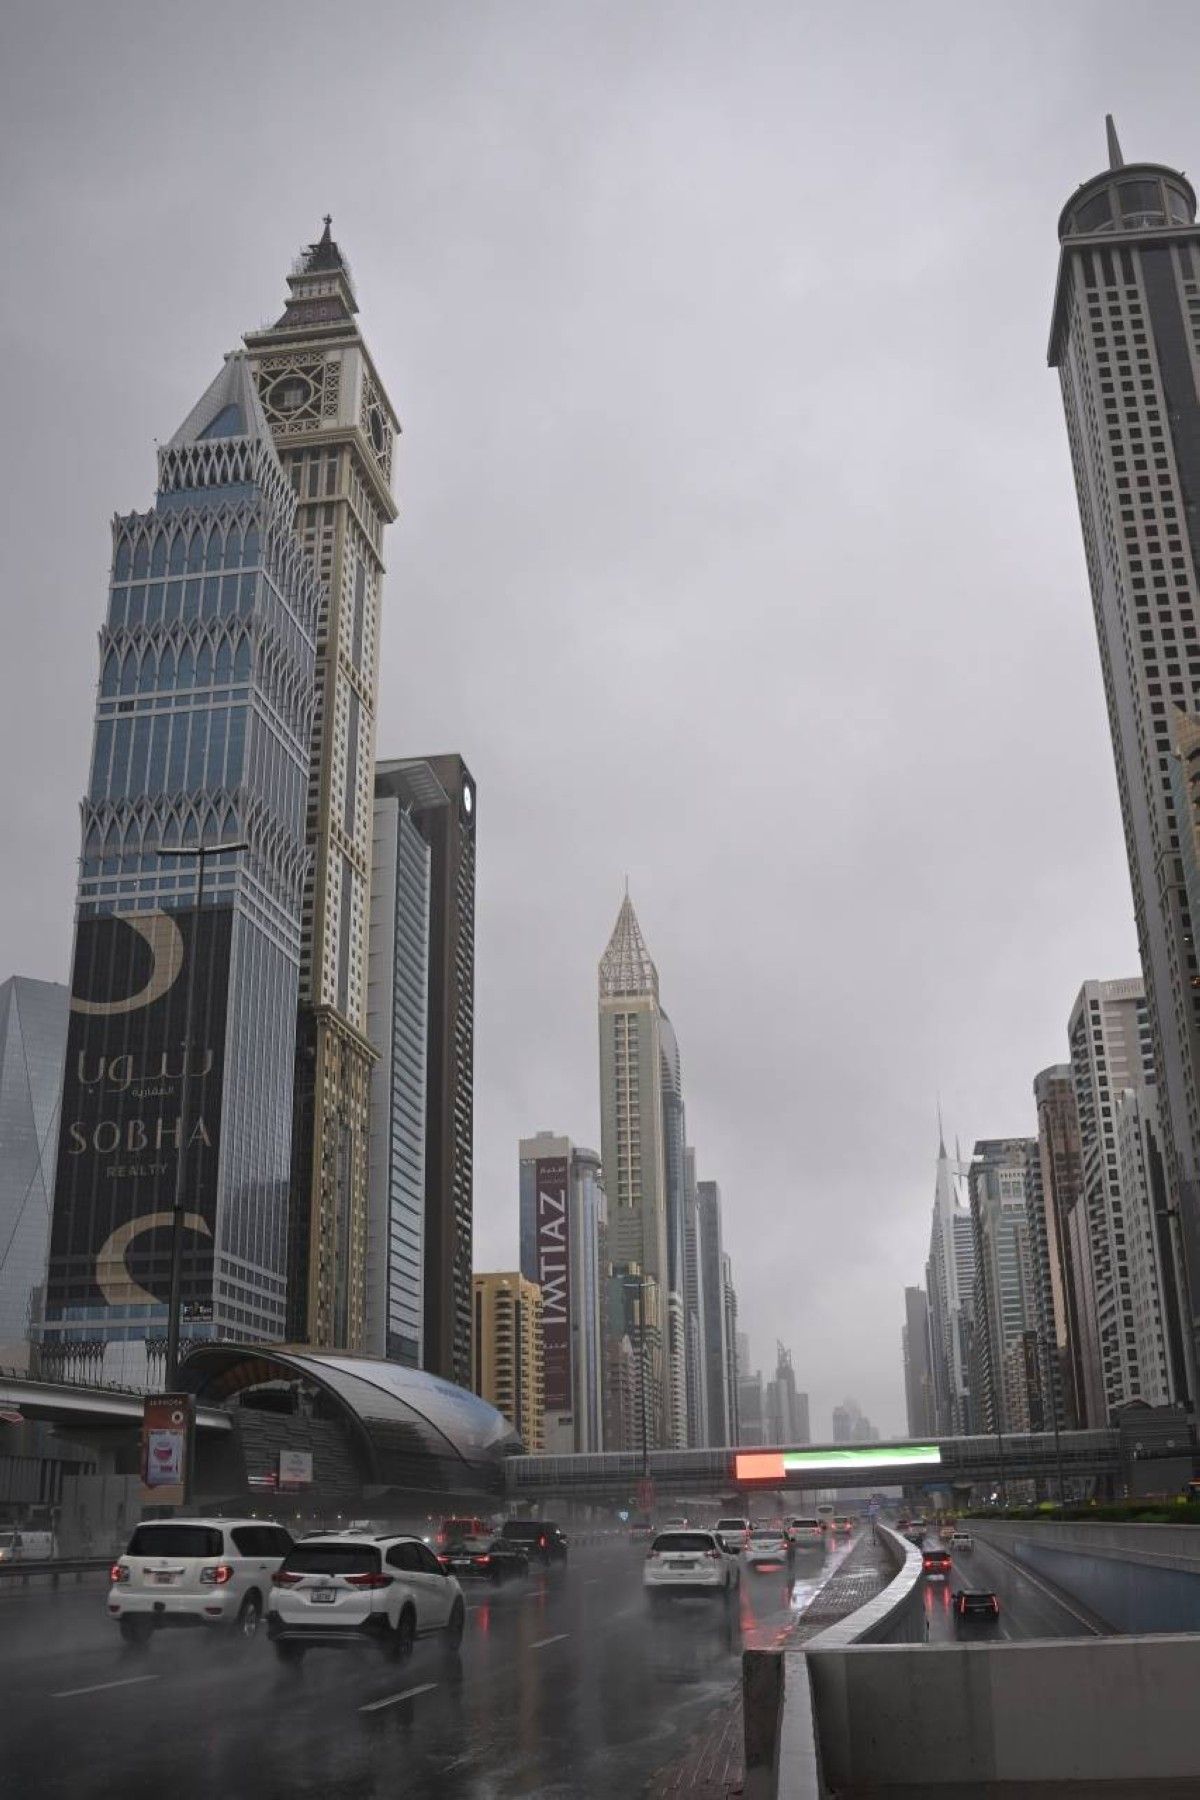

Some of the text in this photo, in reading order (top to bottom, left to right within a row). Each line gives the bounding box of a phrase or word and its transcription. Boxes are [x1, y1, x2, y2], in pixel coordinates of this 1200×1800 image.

[67, 1116, 213, 1155] SOBHA
[106, 1163, 169, 1178] REALTY
[539, 1188, 567, 1324] IMTIAZ
